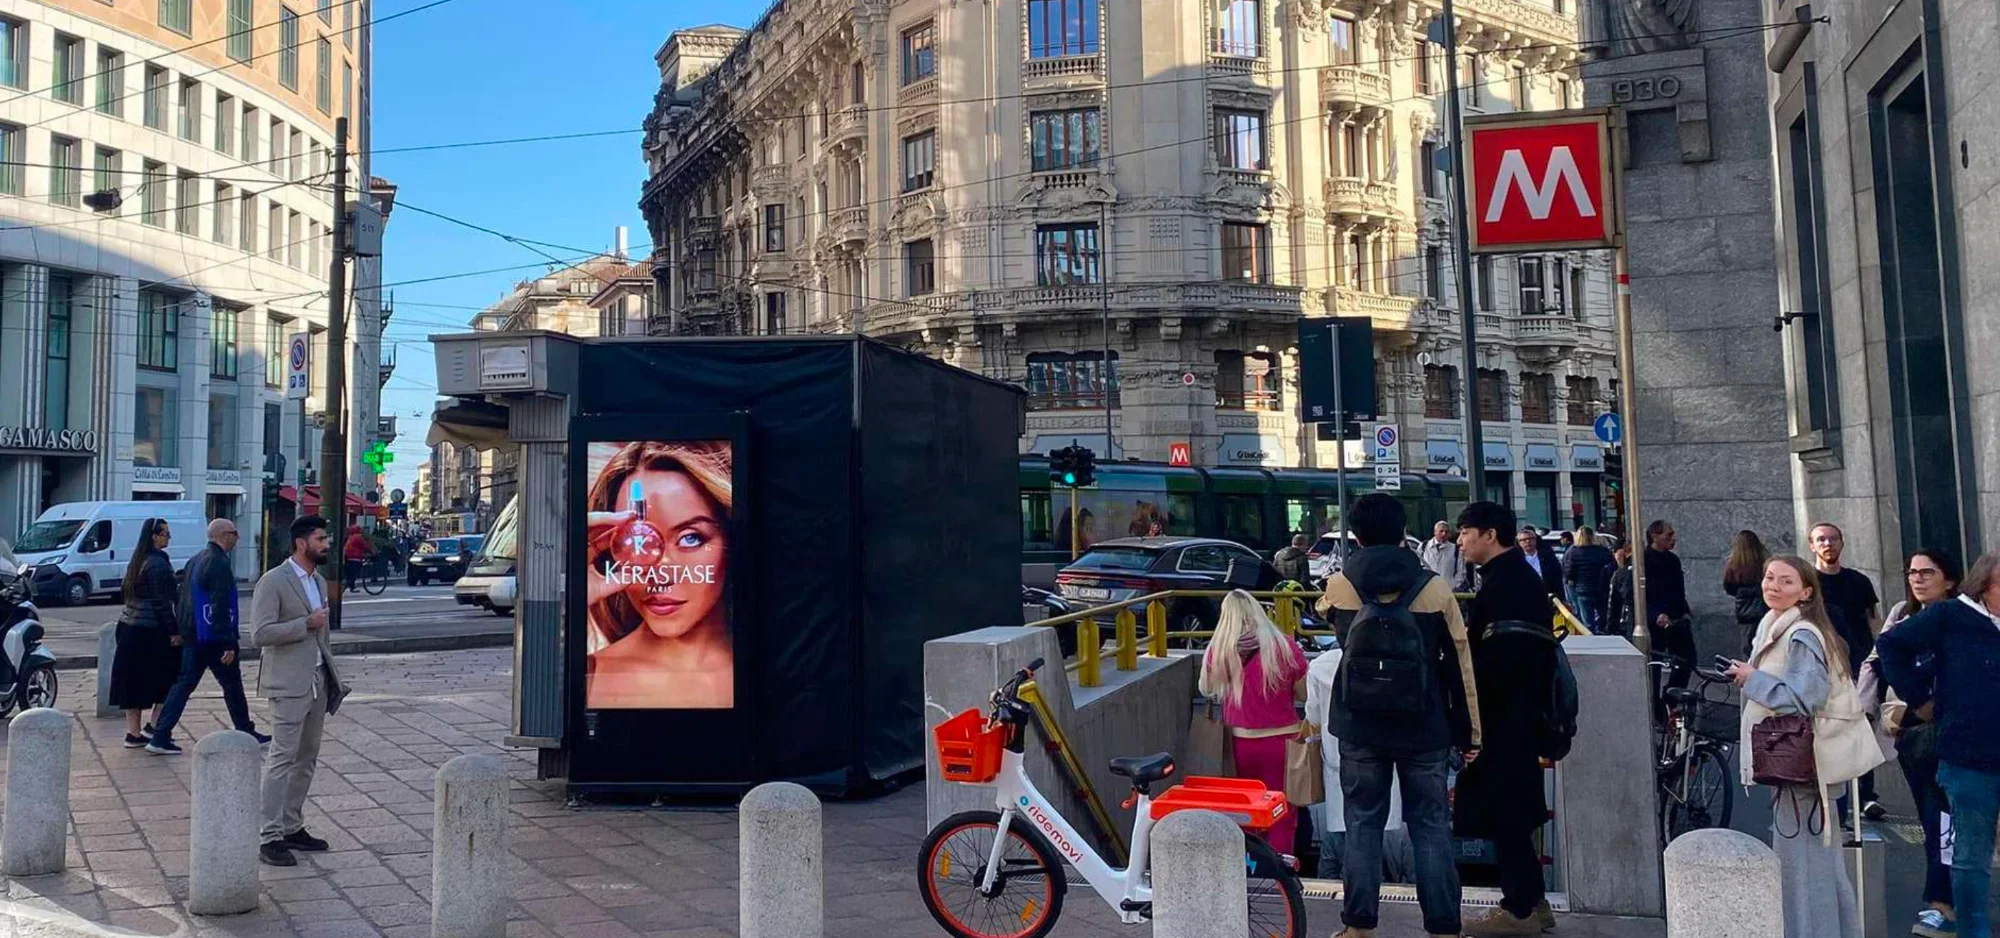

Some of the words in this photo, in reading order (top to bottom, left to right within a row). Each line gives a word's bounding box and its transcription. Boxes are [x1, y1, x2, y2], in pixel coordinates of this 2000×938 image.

[1484, 145, 1597, 223] M
[0, 426, 97, 451] GAMASCO
[1171, 447, 1188, 463] M
[605, 560, 715, 585] KÉRASTASE
[1028, 806, 1084, 863] ridemovi
